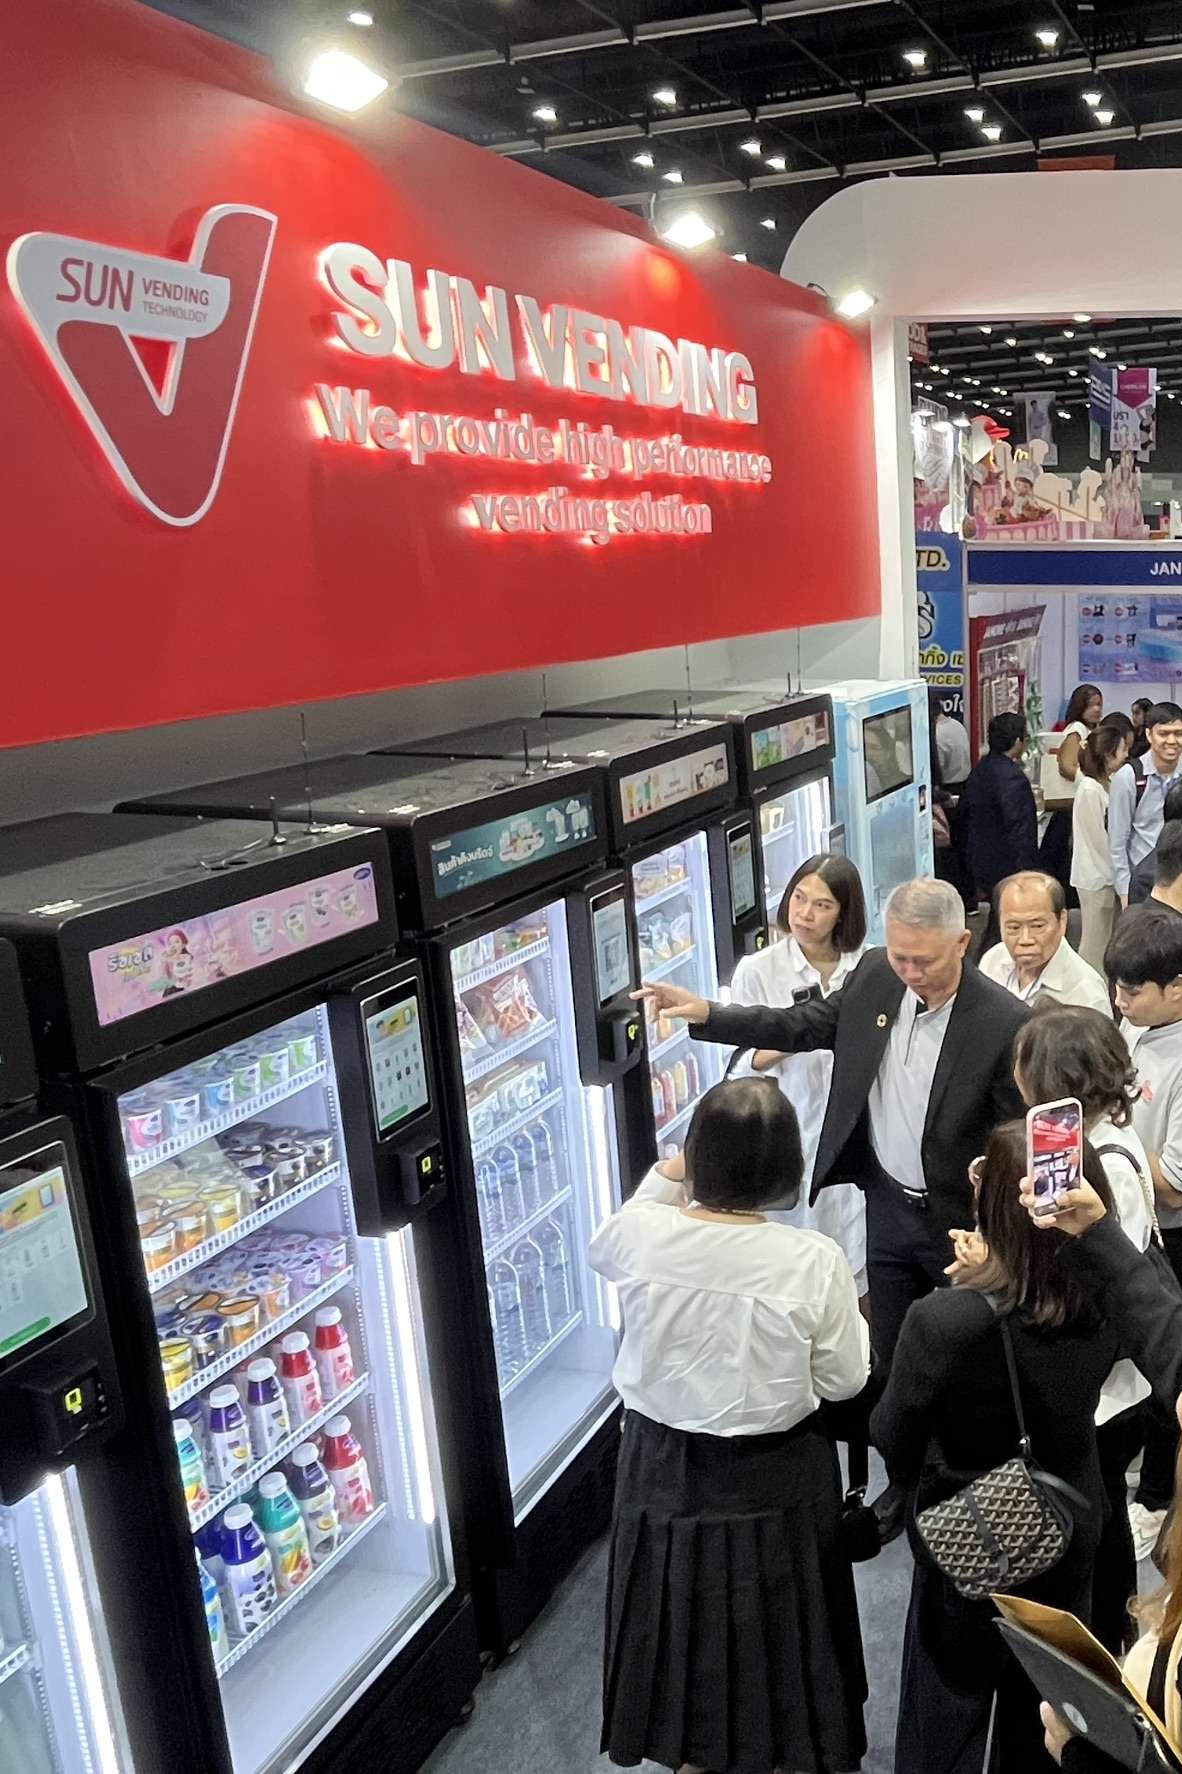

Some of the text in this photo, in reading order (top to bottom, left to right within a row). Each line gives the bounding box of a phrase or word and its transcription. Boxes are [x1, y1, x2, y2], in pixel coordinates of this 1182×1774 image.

[56, 257, 133, 312] SUN
[142, 277, 210, 306] VENDING
[142, 302, 208, 323] TECHNOLOGY
[320, 242, 758, 424] SUN VENDING
[319, 385, 772, 483] We provide high performance
[476, 487, 713, 544] vending solution
